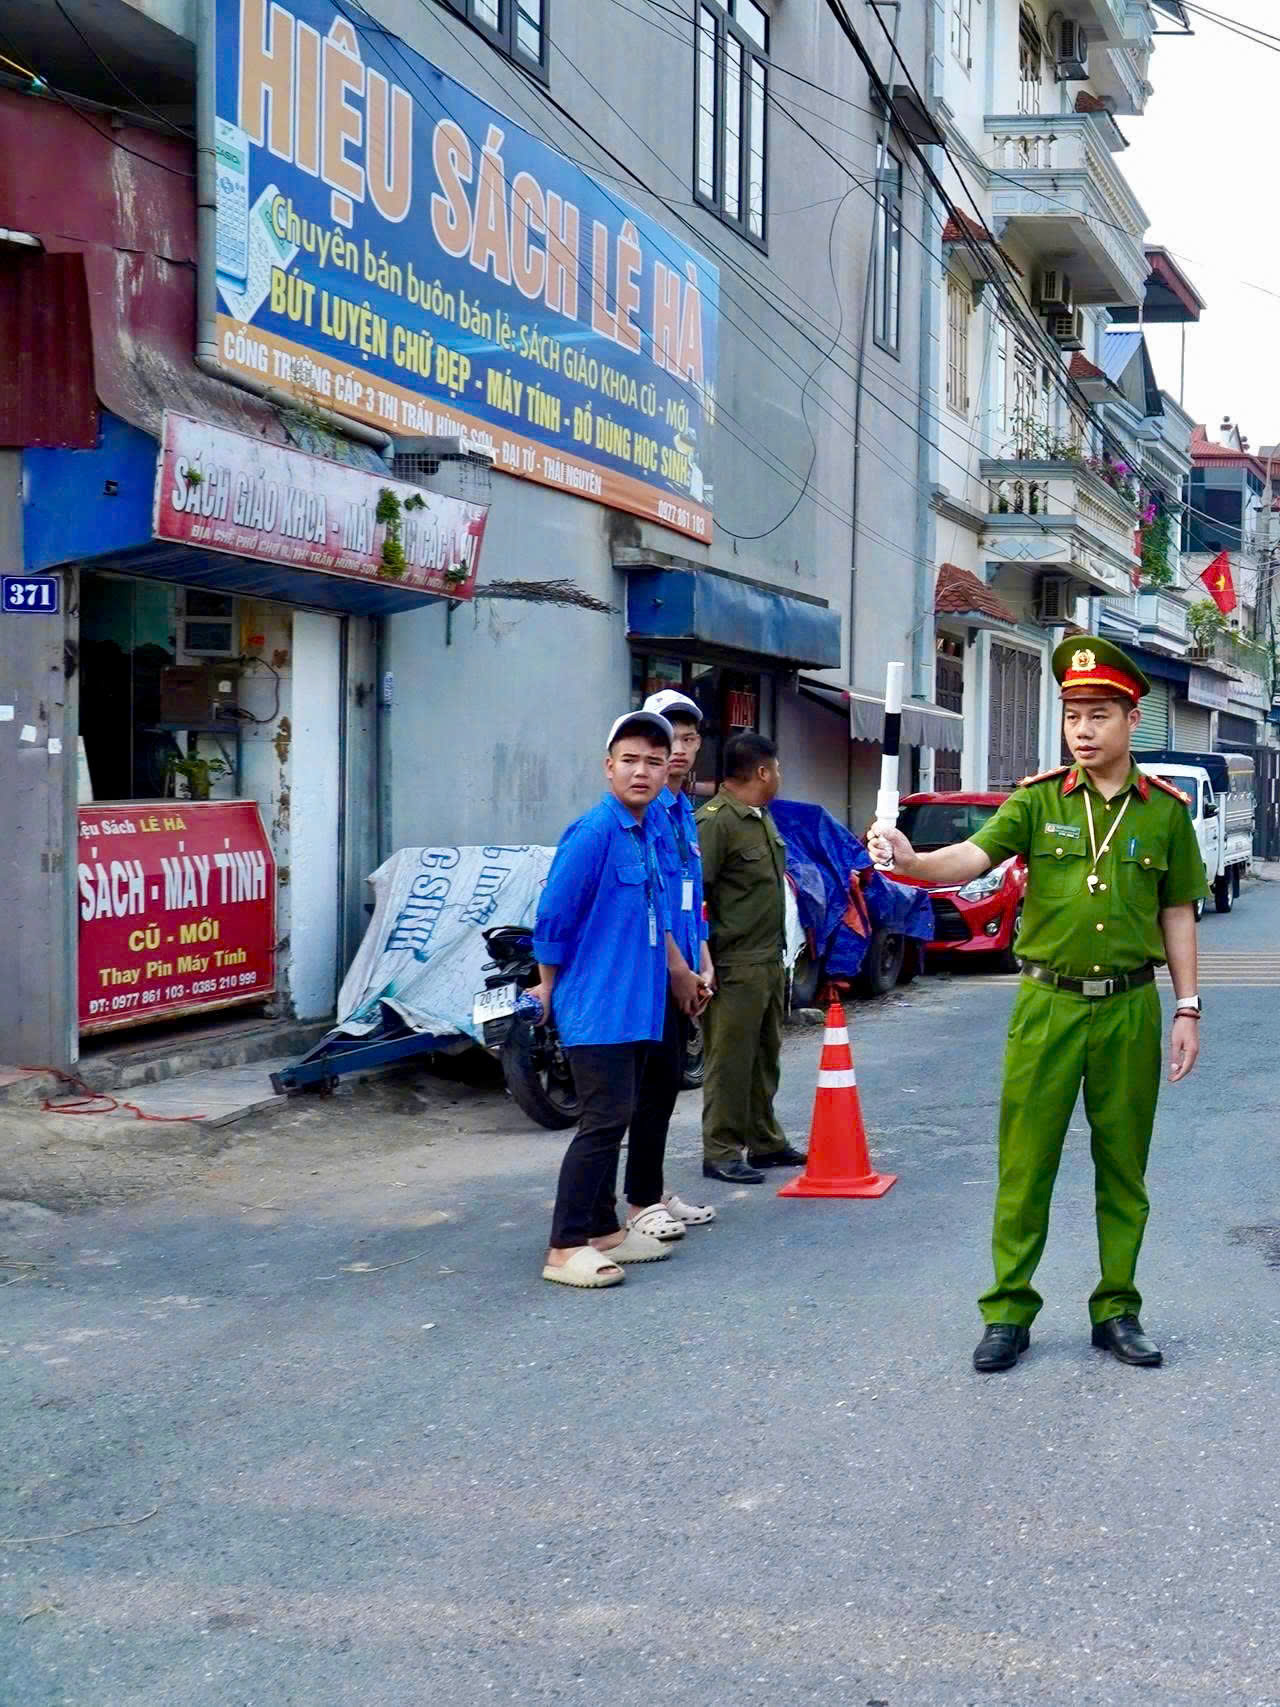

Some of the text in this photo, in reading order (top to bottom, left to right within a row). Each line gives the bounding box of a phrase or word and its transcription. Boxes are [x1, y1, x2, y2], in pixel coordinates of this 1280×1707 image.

[238, 0, 704, 390] HIỆU SÁCH LÊ HÀ
[271, 194, 359, 274] Chuyên
[364, 239, 402, 296] bán
[407, 262, 455, 322] buôn
[460, 290, 492, 340] bán
[519, 323, 560, 372] SÁCH
[563, 347, 599, 390] GIÁO
[601, 364, 639, 412] KHOA
[640, 383, 657, 417] CŨ
[271, 265, 690, 487] BÚT LUYỆN CHỮ ĐẸP - MÁY TÍNH - ĐỒ DÙNG HỌC SINH
[335, 371, 363, 406] CẤP
[365, 386, 375, 412] 3
[378, 391, 398, 427] THỊ
[401, 399, 433, 436] TRẤN
[502, 440, 520, 471] ĐẠI
[172, 451, 231, 520] SÁCH
[232, 467, 279, 533] GIÁO
[280, 485, 327, 545] KHOA
[10, 584, 50, 606] 371
[102, 819, 136, 834] Sách
[139, 816, 160, 833] LÊ
[163, 813, 187, 831] HÀ
[78, 838, 266, 921] SÁCH - MÁY TÍNH
[385, 874, 451, 954] SINH
[99, 948, 247, 986] Thay Pin Máy Tính
[128, 922, 160, 952] CŨ
[180, 916, 219, 944] MỚI
[89, 999, 110, 1014] ĐT:
[112, 993, 139, 1010] 0977
[141, 988, 161, 1004] 861
[165, 984, 184, 999] 103
[192, 978, 217, 994] 0385
[219, 974, 237, 990] 210
[239, 971, 257, 986] 999
